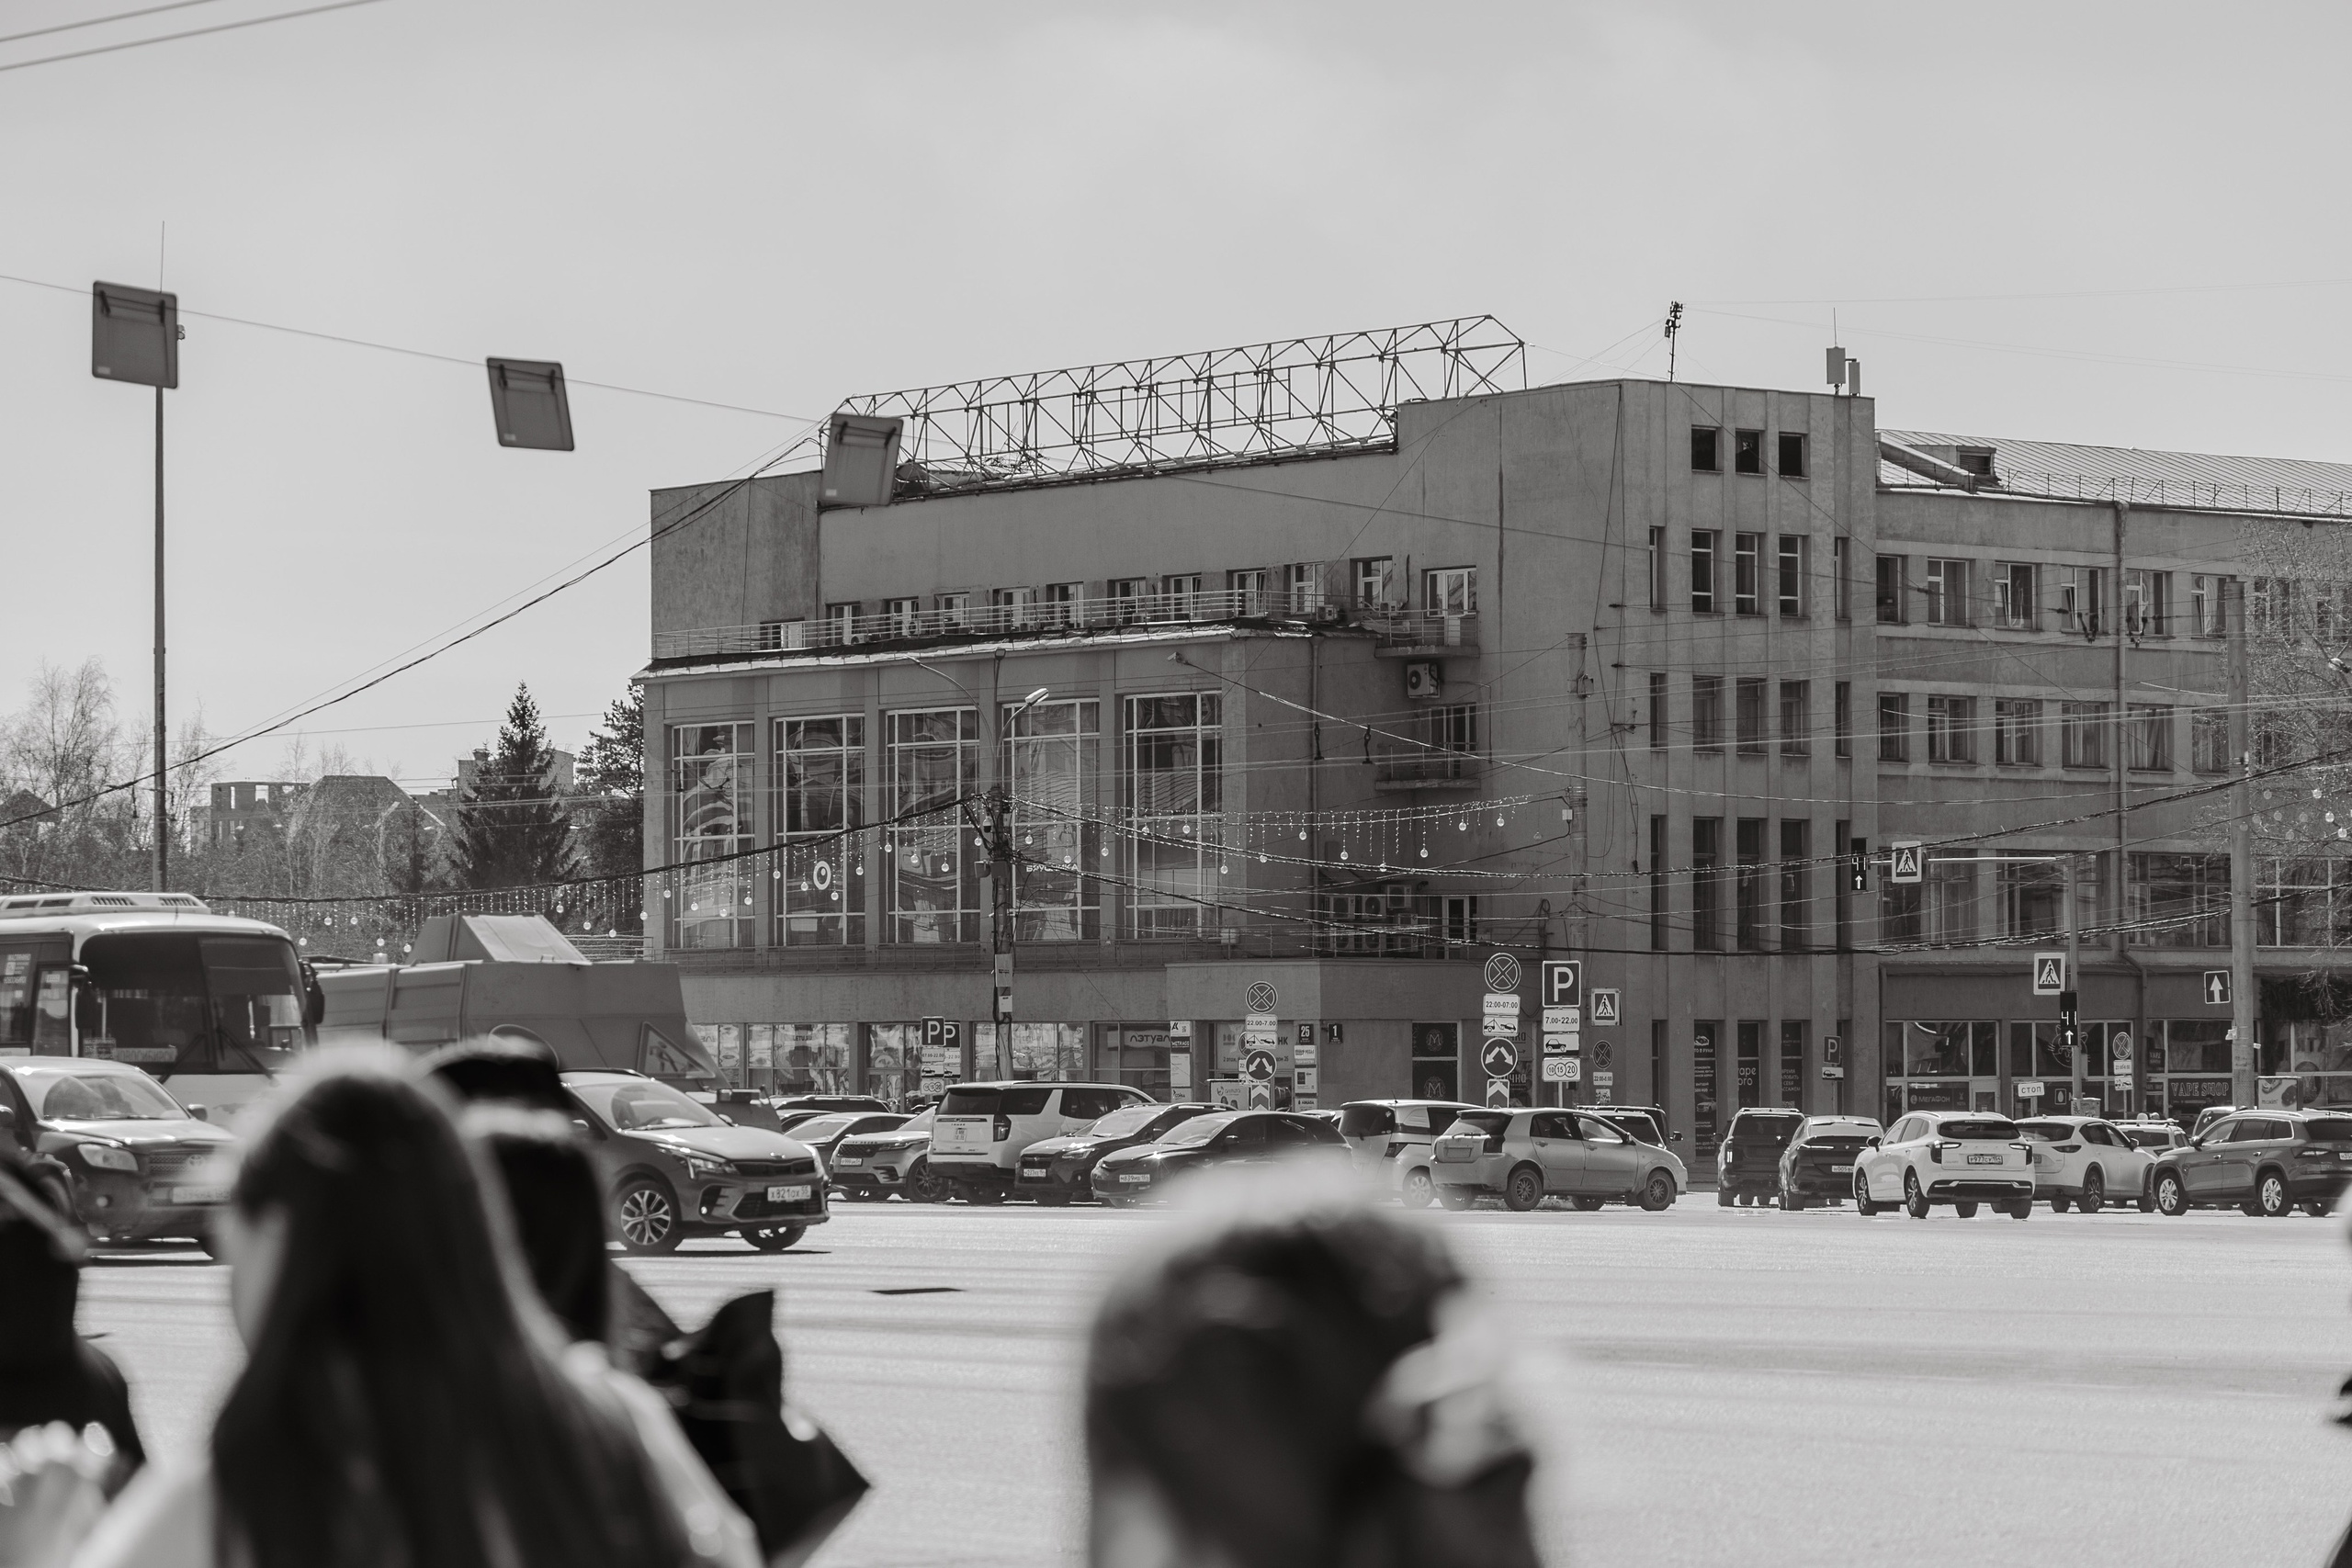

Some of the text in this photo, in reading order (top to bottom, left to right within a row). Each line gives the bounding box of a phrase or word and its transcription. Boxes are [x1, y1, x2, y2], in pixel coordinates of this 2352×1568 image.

[1852, 857, 1866, 871] 41
[1554, 966, 1574, 1002] P
[1486, 1000, 1519, 1009] 22:00-07:00
[1545, 1016, 1578, 1024] 7.00-22.00
[2061, 1010, 2077, 1026] 41
[927, 1021, 941, 1043] P
[1301, 1025, 1310, 1037] 25
[1332, 1024, 1338, 1036] 1
[1827, 1039, 1838, 1061] P
[1557, 1065, 1564, 1074] 15
[1566, 1065, 1577, 1074] 20
[2021, 1086, 2042, 1094] СТОП
[2170, 1082, 2230, 1097] VAPE SHOP
